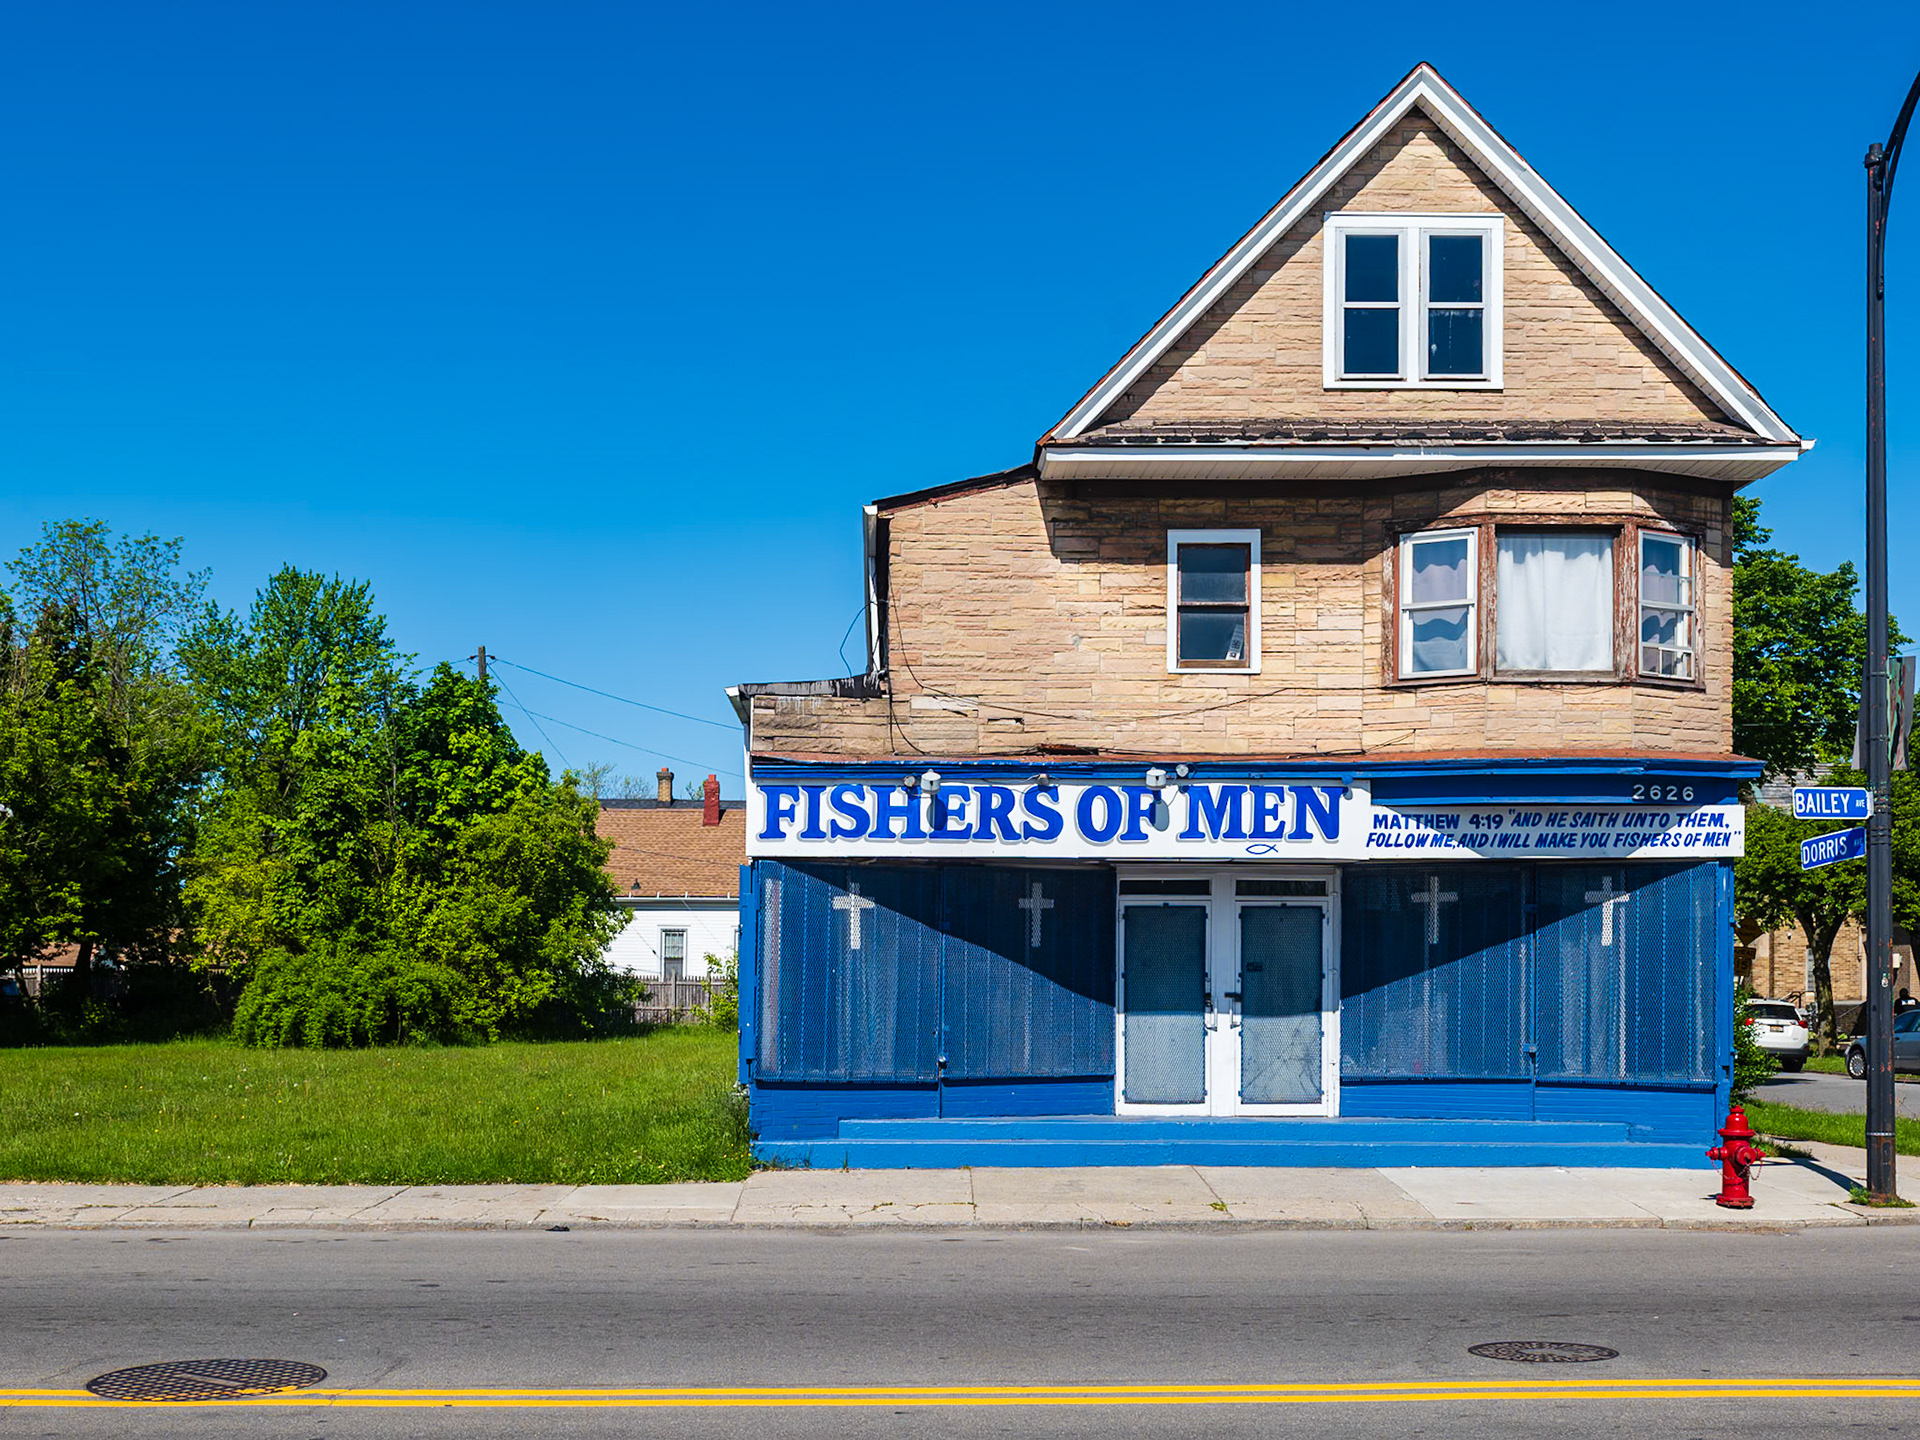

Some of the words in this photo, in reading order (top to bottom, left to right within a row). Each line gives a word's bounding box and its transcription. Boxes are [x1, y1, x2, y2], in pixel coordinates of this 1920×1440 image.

[1632, 783, 1695, 801] 2626
[758, 783, 1064, 841] FISHERS
[1076, 784, 1163, 842] OF
[1178, 784, 1346, 840] MEN
[1795, 792, 1850, 814] BAILEY
[1855, 798, 1866, 808] AVE
[1372, 813, 1460, 830] MATTHEW
[1468, 813, 1504, 829] 4:19
[1545, 811, 1569, 828] HE
[1569, 811, 1620, 828] SAITH
[1622, 812, 1671, 828] UNTO
[1366, 832, 1431, 848] FOLLOW
[1496, 832, 1530, 848] WILL
[1534, 832, 1578, 848] MAKE
[1579, 832, 1611, 848] YOU
[1612, 832, 1682, 848] FISHERS
[1683, 832, 1702, 848] OF
[1802, 835, 1848, 865] DORRIS
